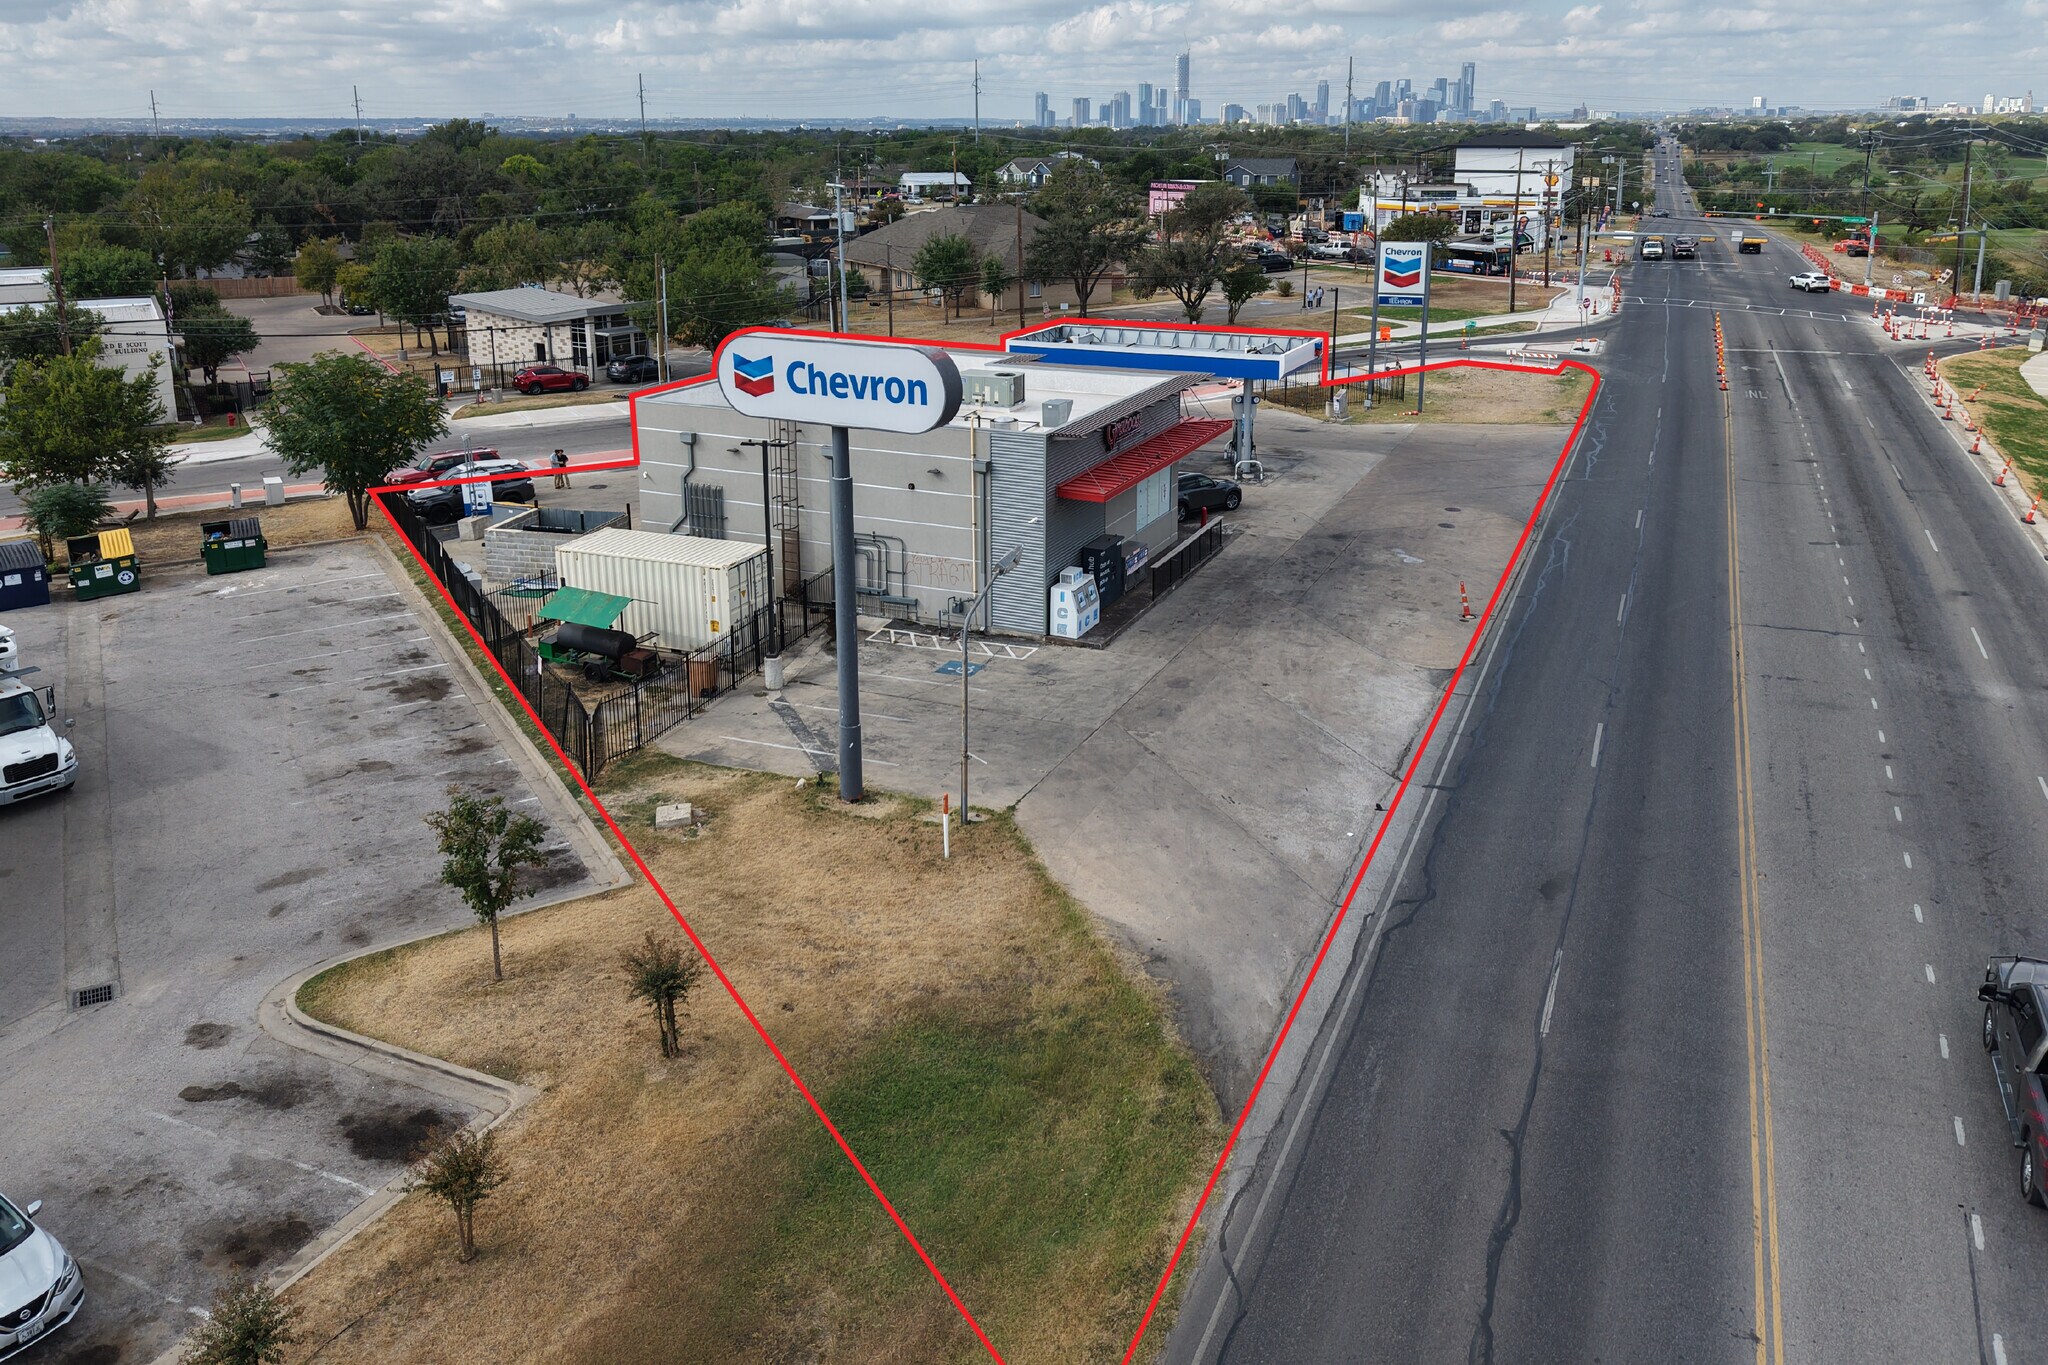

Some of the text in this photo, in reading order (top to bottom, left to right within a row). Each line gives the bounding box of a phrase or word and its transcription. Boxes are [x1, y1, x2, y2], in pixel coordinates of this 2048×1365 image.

[1385, 247, 1422, 256] Chevron
[786, 360, 928, 406] Chevron
[1056, 591, 1069, 636] ICE
[1078, 608, 1098, 632] ICE
